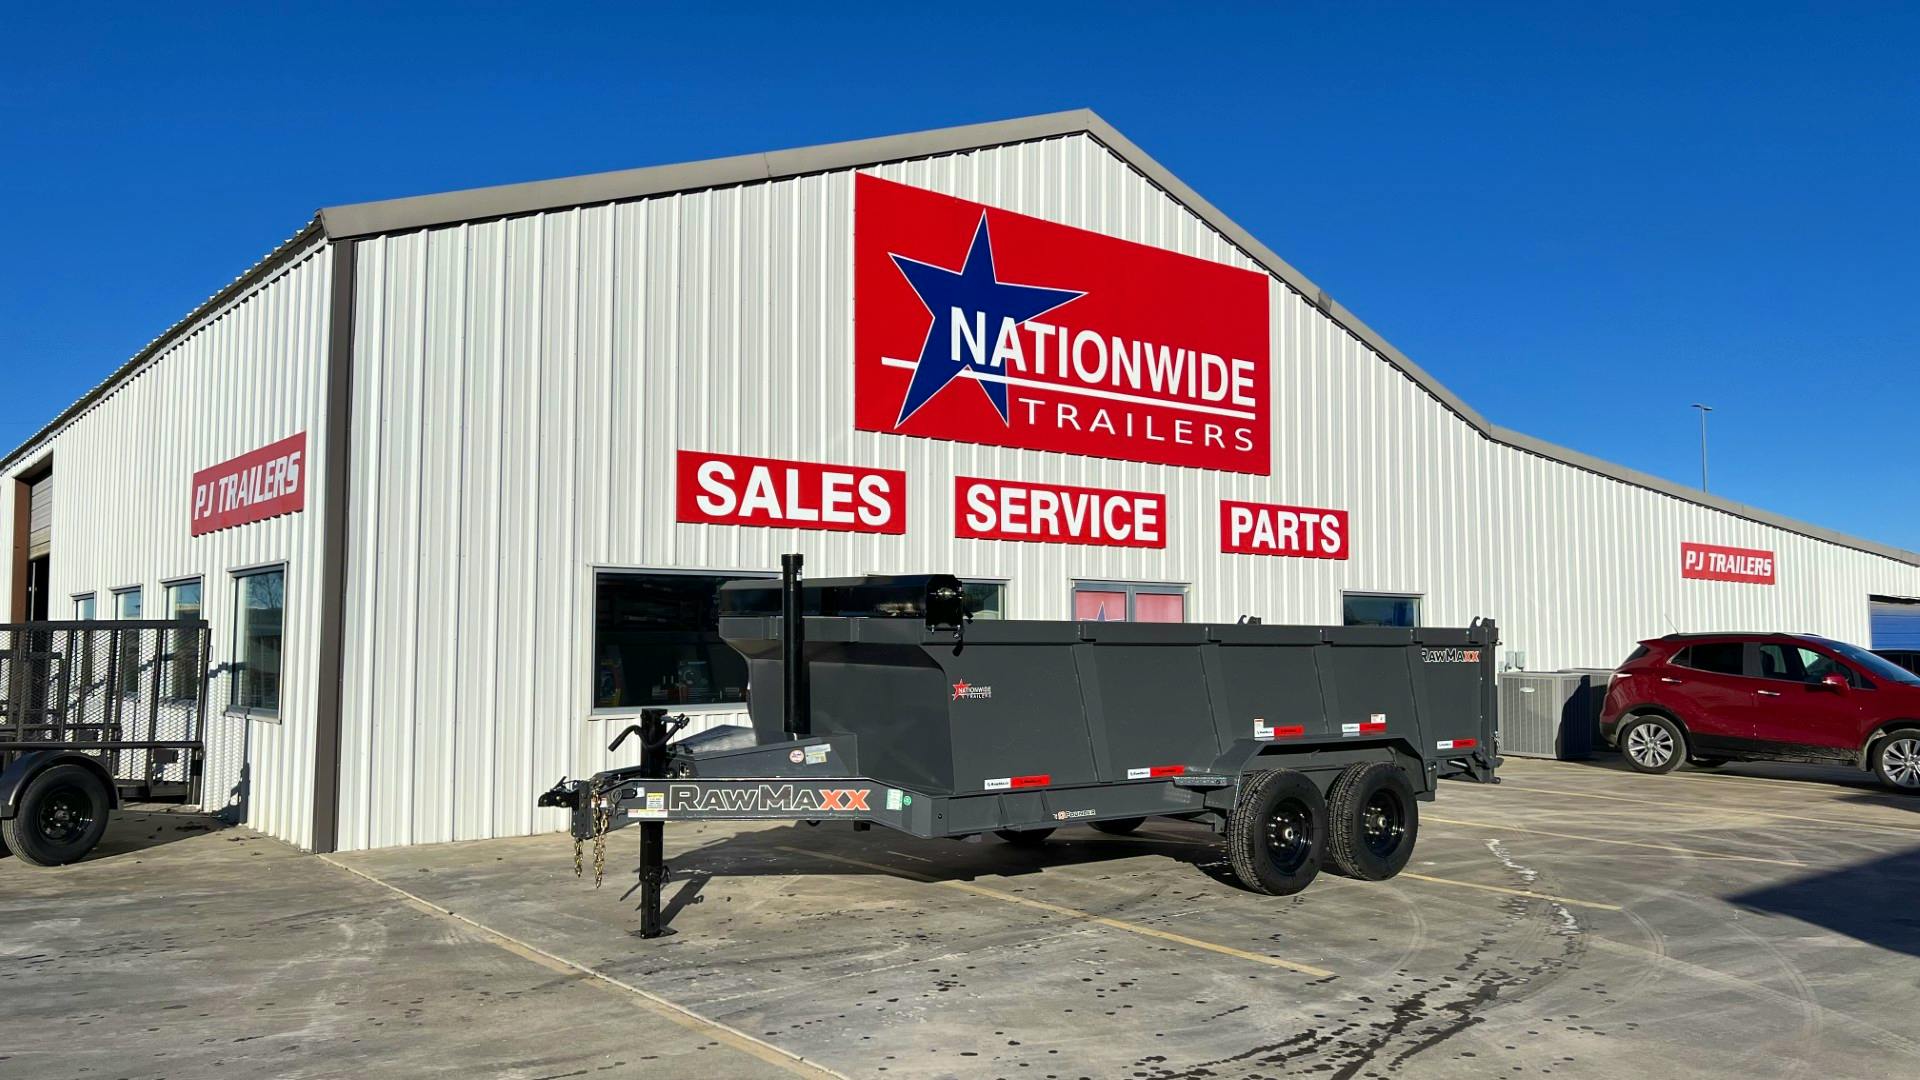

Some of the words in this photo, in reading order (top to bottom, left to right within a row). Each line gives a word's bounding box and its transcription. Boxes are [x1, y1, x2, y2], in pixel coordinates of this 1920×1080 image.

[950, 305, 1256, 407] NATIONWIDE
[1018, 397, 1254, 452] TRAILERS
[194, 481, 215, 520] PJ
[218, 450, 301, 513] TRAILERS
[696, 460, 891, 526] SALES
[966, 483, 1159, 542] SERVICE
[1230, 506, 1341, 554] PARTS
[1685, 550, 1704, 571] PJ
[1708, 552, 1772, 577] TRAILERS
